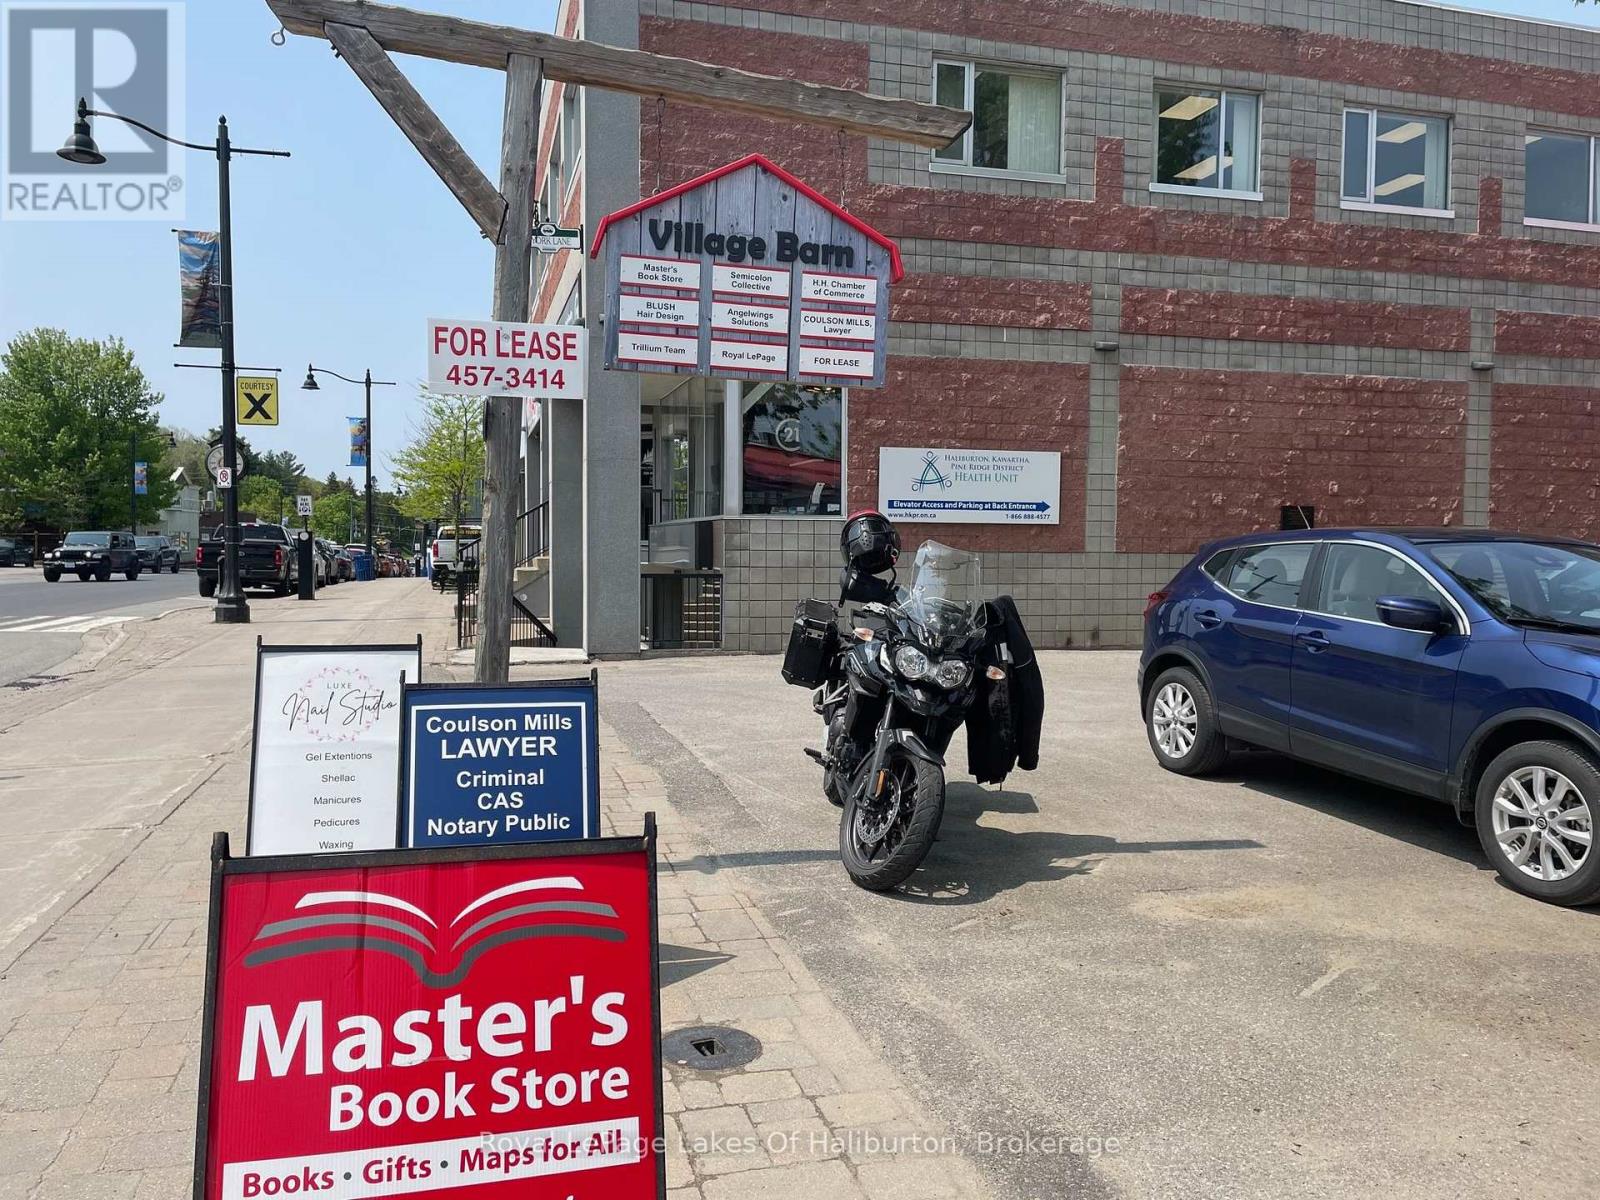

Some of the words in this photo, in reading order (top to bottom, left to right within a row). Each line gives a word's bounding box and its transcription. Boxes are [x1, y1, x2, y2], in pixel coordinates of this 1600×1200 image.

[553, 237, 571, 245] LANE
[649, 218, 766, 262] Village
[776, 231, 854, 267] Barn
[643, 263, 678, 273] Master's
[638, 272, 659, 281] Book
[661, 274, 683, 283] Store
[730, 271, 773, 282] Semicolon
[731, 281, 771, 291] Collective
[812, 279, 829, 287] H.H.
[831, 280, 866, 290] Chamber
[823, 289, 865, 299] Commerce
[646, 301, 676, 311] BLUSH
[637, 310, 654, 319] Hair
[656, 311, 684, 321] Design
[727, 308, 774, 320] Angelwings
[731, 317, 769, 328] Solutions
[803, 315, 844, 325] COULSON
[846, 318, 872, 328] MILLS,
[823, 326, 852, 335] Lawyer
[434, 326, 487, 357] FOR
[496, 329, 577, 361] LEASE
[631, 343, 662, 352] Trillium
[664, 346, 686, 354] Team
[722, 350, 745, 360] Royal
[747, 352, 776, 362] LePage
[814, 357, 831, 365] FOR
[833, 358, 860, 367] LEASE
[446, 364, 565, 390] 457-3414
[240, 382, 274, 391] COURTESY
[784, 427, 799, 443] 21
[955, 472, 991, 482] HEALTH
[994, 473, 1018, 483] UNIT
[893, 500, 921, 508] Elevator
[944, 501, 958, 509] and
[958, 502, 984, 510] Parking
[1008, 502, 1037, 510] Entrance
[888, 511, 937, 519] www.hkpr.on.ca
[326, 682, 353, 690] LUXE
[282, 691, 335, 731] Nail
[339, 688, 398, 726] Studio
[426, 715, 517, 734] Coulson
[524, 714, 572, 731] Mills
[441, 736, 558, 759] LAWYER
[305, 752, 322, 762] Gel
[324, 752, 373, 761] Extentions
[321, 773, 356, 783] Shellac
[456, 769, 544, 788] Criminal
[313, 795, 362, 805] Manicures
[477, 792, 524, 810] CAS
[313, 818, 361, 828] Pedicures
[427, 818, 498, 838] Notary
[506, 813, 571, 832] Public
[318, 840, 354, 850] Waxing
[237, 975, 629, 1082] Master's
[329, 1071, 477, 1132] Book
[490, 1065, 630, 1115] Store
[243, 1167, 334, 1198] Books
[362, 1155, 432, 1186] Gifts
[459, 1143, 534, 1174] Maps
[543, 1136, 581, 1163] for
[588, 1129, 622, 1157] All
